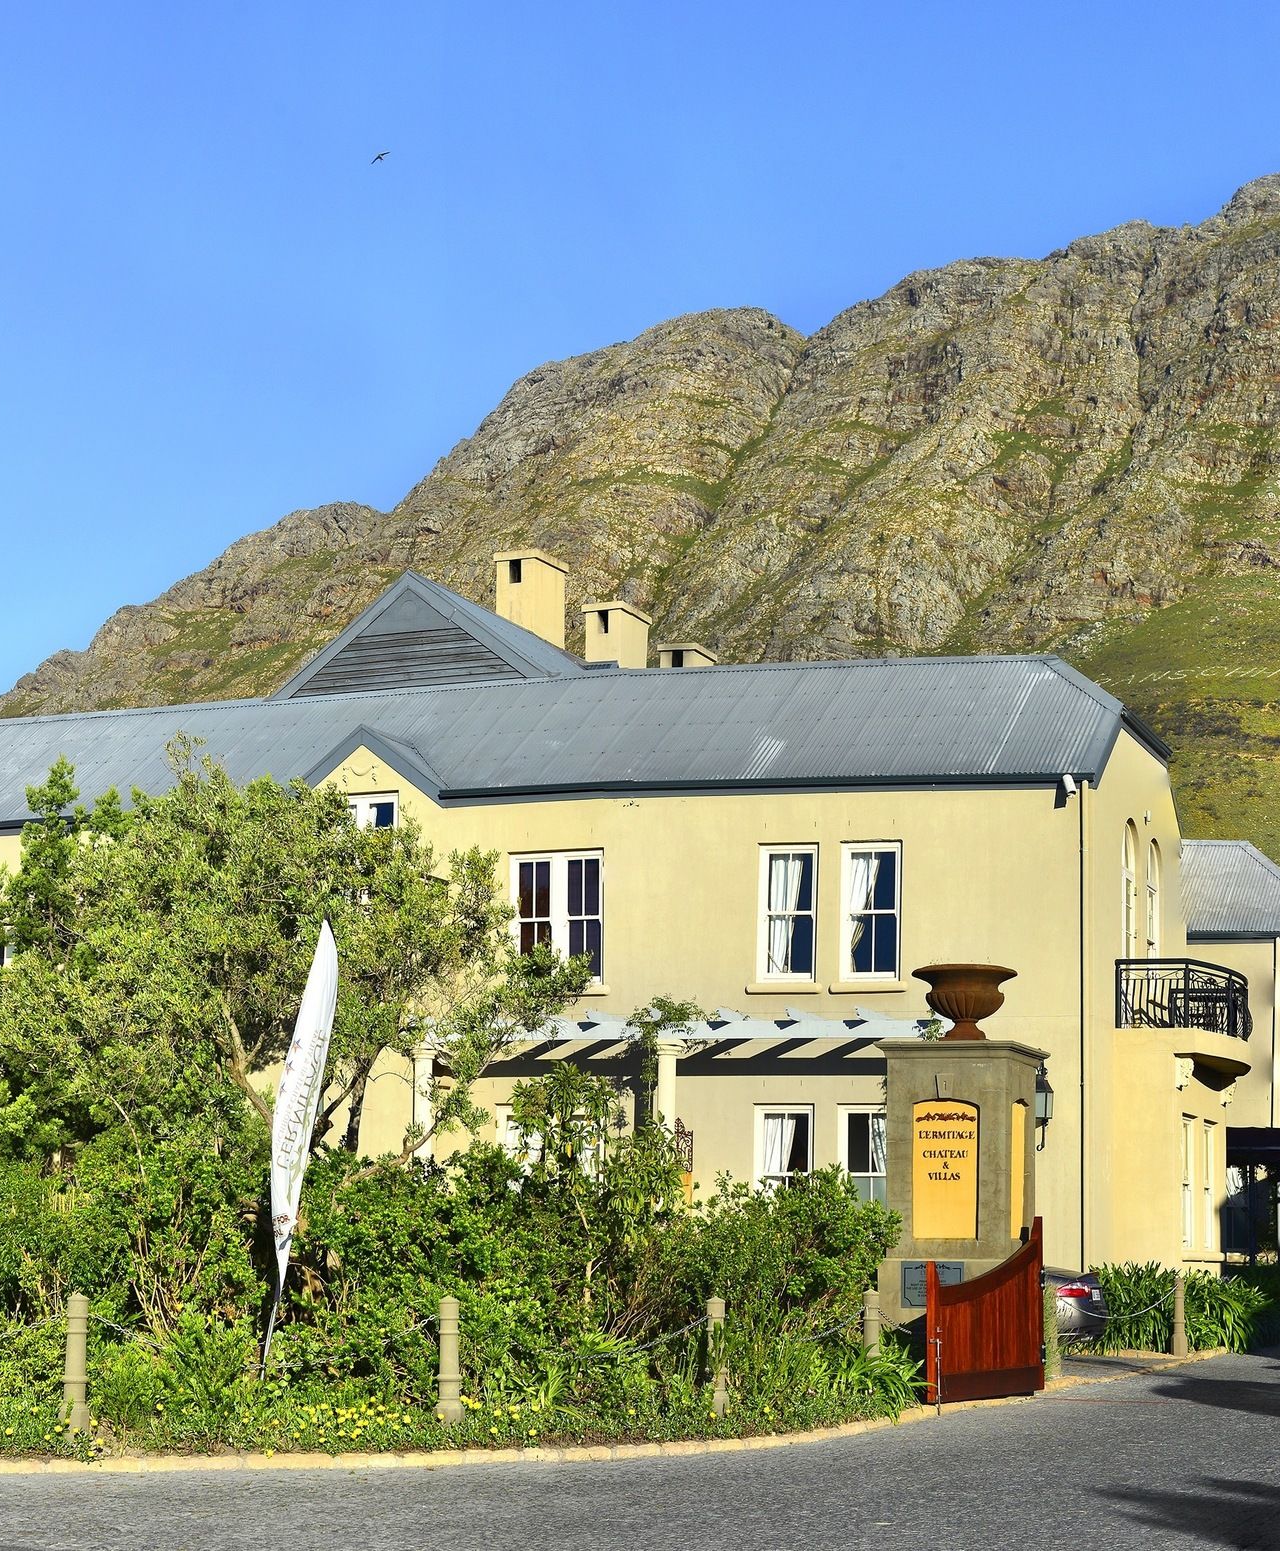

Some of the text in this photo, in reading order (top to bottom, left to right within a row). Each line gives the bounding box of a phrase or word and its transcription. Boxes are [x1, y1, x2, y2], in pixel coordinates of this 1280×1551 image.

[918, 1130, 975, 1140] L'ERMITAGE
[922, 1149, 968, 1159] CHATEAU
[942, 1161, 950, 1170] &
[928, 1171, 961, 1181] VILLAS
